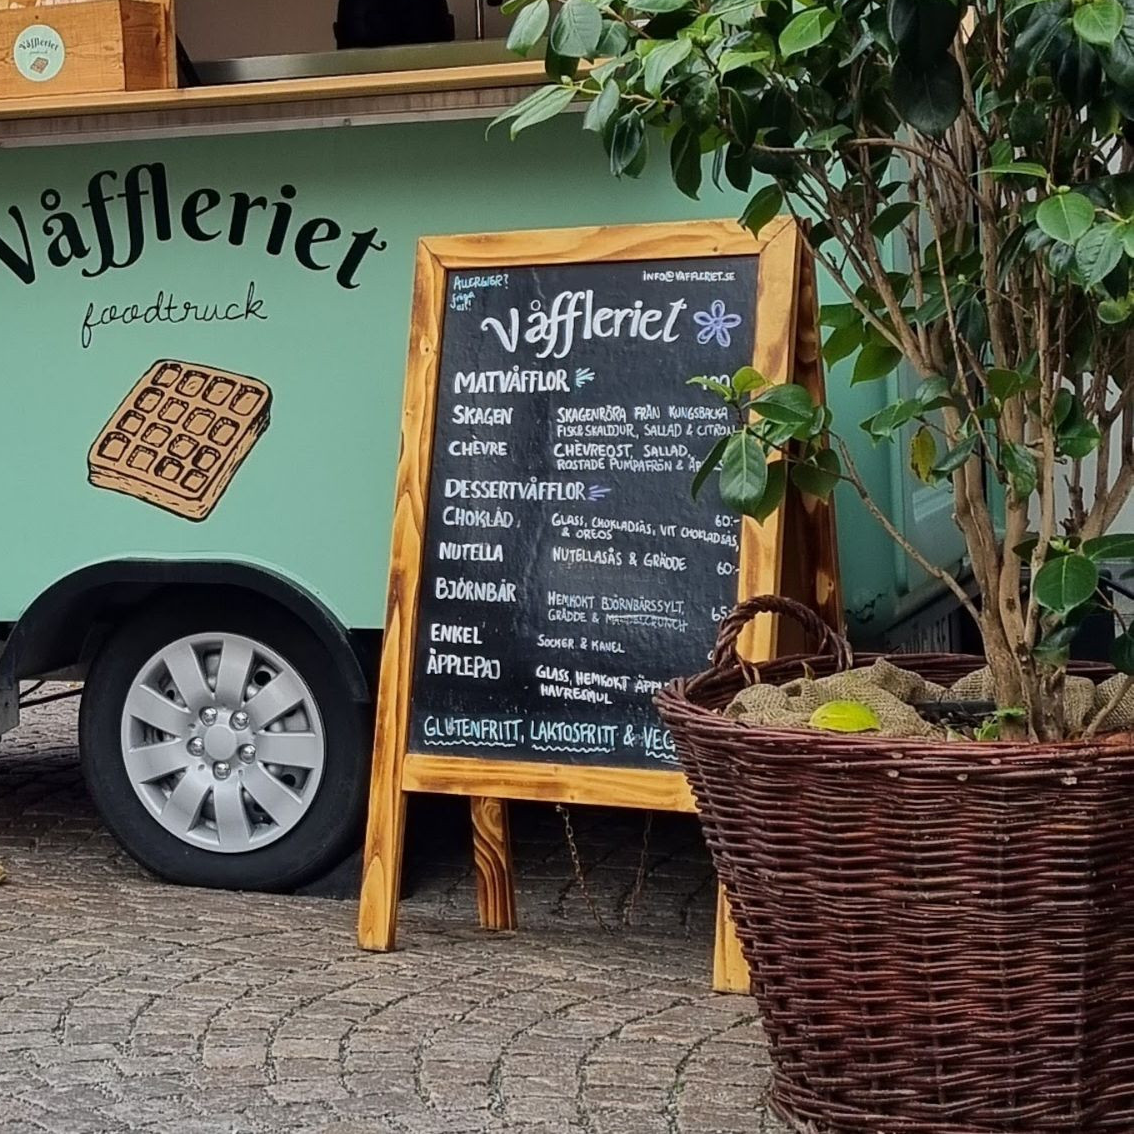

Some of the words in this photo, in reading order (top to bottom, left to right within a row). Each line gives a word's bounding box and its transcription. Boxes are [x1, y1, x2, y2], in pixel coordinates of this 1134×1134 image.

[81, 281, 268, 349] foodtruck
[454, 365, 570, 394] MATVÅFFLOR
[452, 404, 514, 426] SKAGEN
[556, 405, 626, 423] SKAGENRÖRA
[634, 404, 660, 420] FRÅN
[669, 406, 729, 421] KUNGSBACKA
[644, 424, 682, 437] SALLAD
[448, 435, 508, 456] CHÈVRE
[557, 458, 605, 471] ROSTADE
[445, 476, 586, 501] DESSERTVÅFFLOR
[561, 527, 570, 537] &
[576, 528, 613, 541] OREOS
[660, 524, 677, 538] VIT
[439, 542, 503, 562] NUTELLA
[553, 546, 623, 566] NUTELLASÅS
[629, 552, 637, 566] &
[643, 551, 687, 571] GRÄDDE
[435, 577, 516, 602] BJÖRNBÄR
[592, 614, 599, 624] &
[431, 623, 483, 644] ENKEL
[537, 634, 574, 650] SOCKER
[580, 637, 588, 650] &
[592, 639, 625, 654] KANEL
[426, 647, 501, 679] ÄPPLEPAJ
[576, 670, 631, 691] HEMKOKT
[531, 720, 618, 746] LAKTOSFRITT
[623, 724, 634, 746] &
